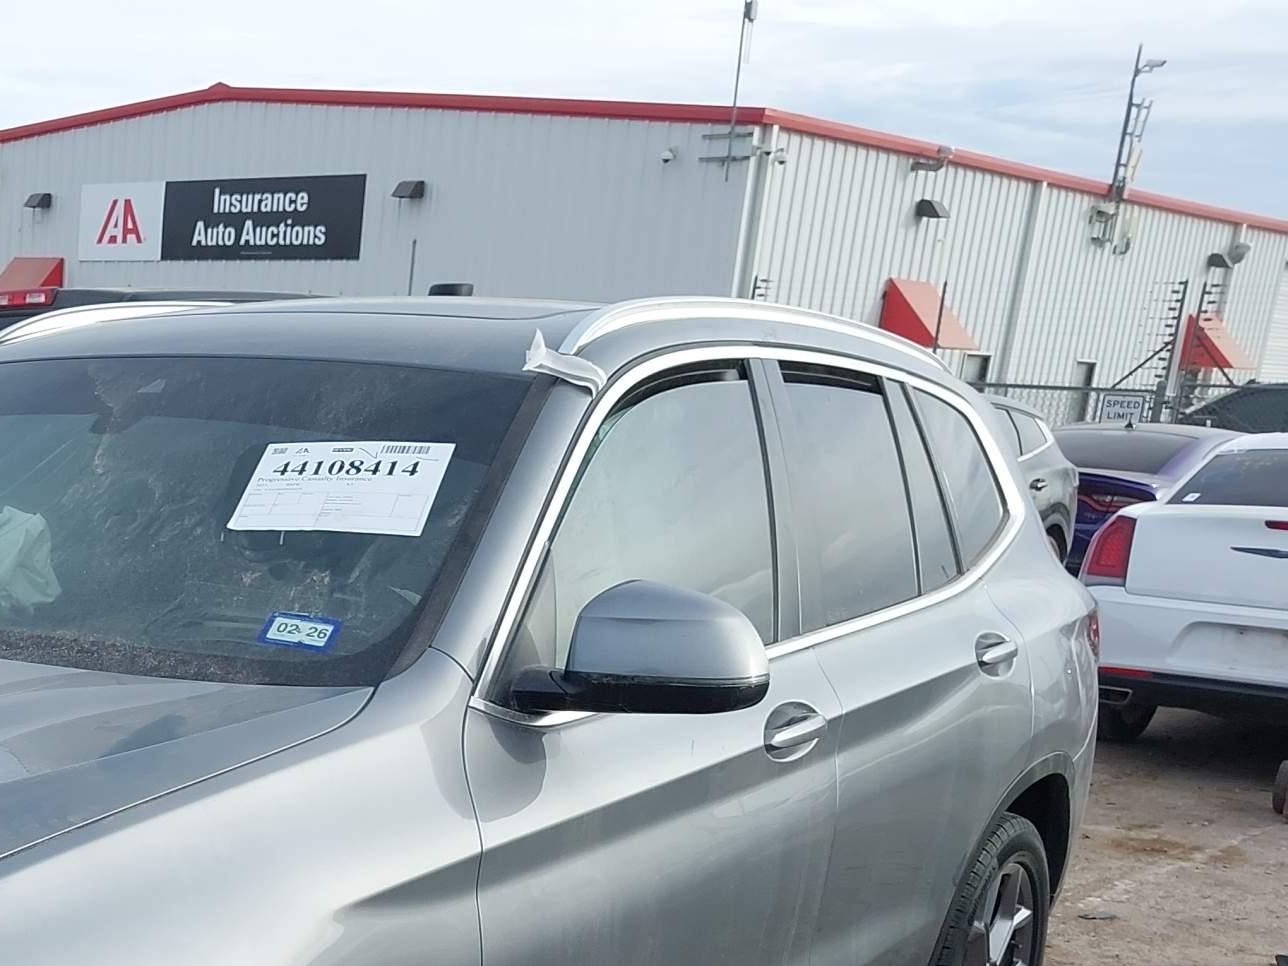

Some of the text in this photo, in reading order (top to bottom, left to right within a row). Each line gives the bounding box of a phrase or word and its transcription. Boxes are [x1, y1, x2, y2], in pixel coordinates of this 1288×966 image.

[212, 186, 309, 214] Insurance
[191, 218, 327, 247] Auto Auctions
[1106, 399, 1141, 409] SPEED
[1106, 410, 1135, 421] LIMIT
[273, 459, 421, 477] 44108414
[276, 622, 330, 640] 02 26
